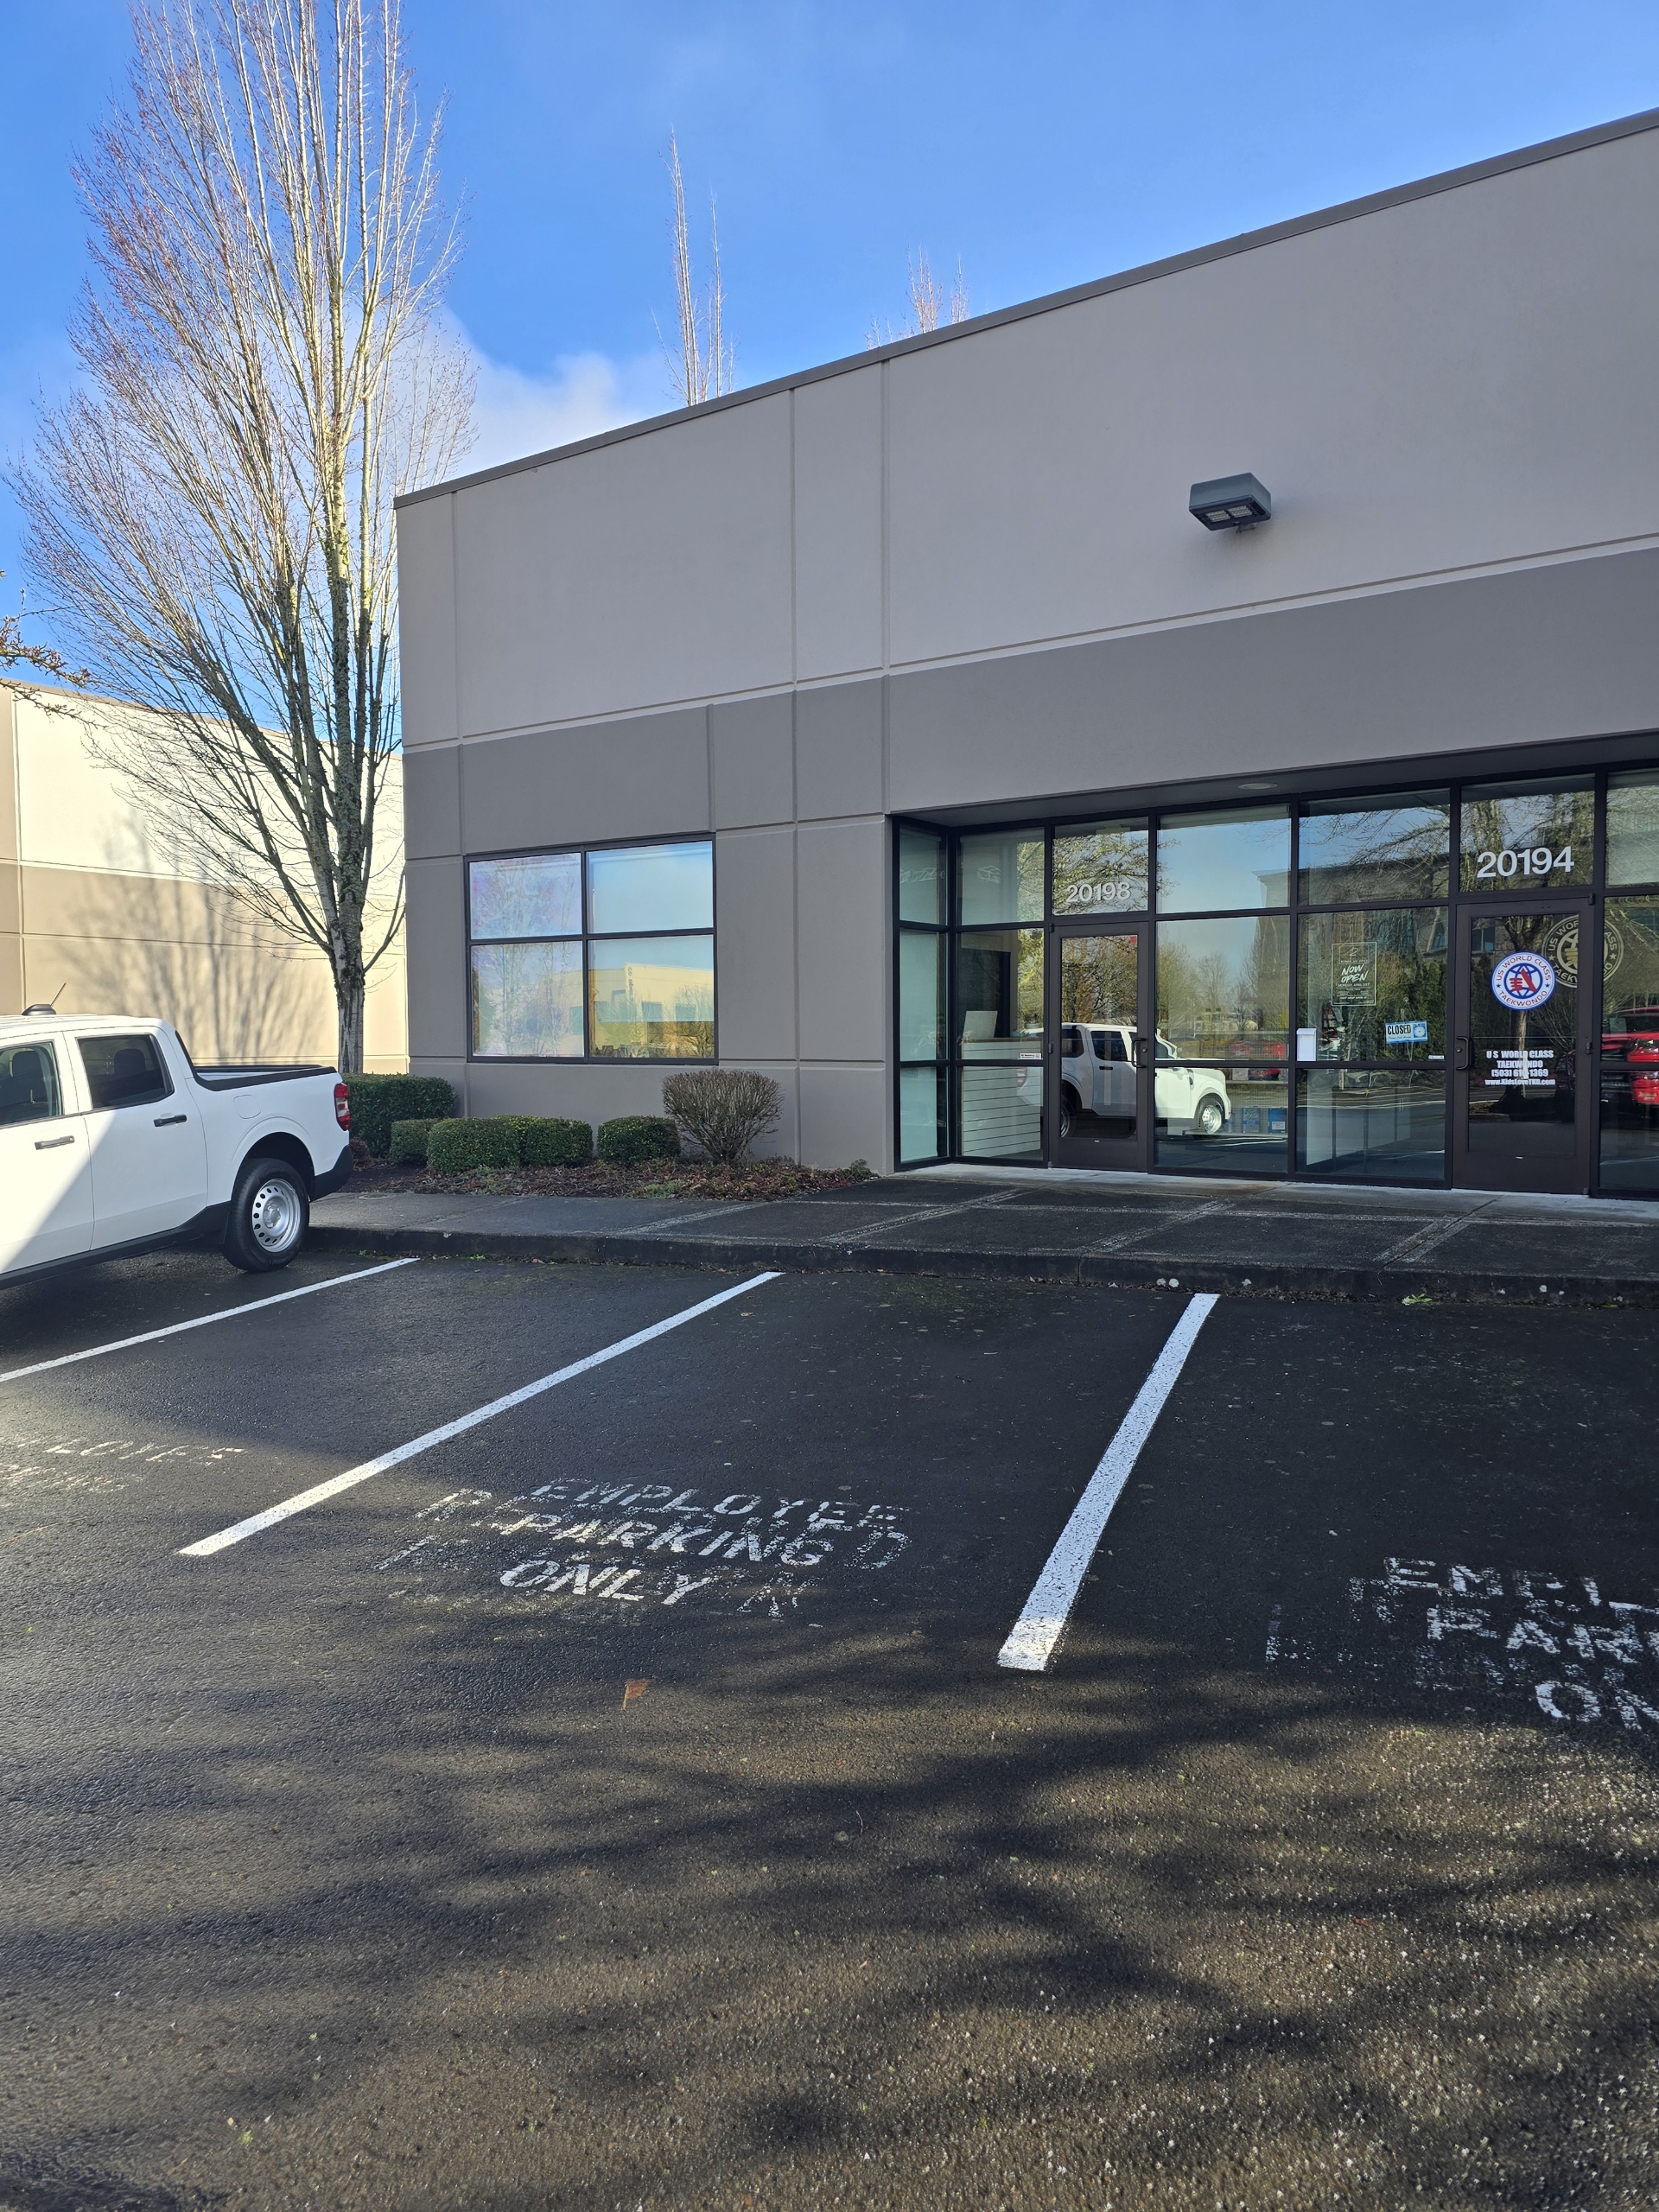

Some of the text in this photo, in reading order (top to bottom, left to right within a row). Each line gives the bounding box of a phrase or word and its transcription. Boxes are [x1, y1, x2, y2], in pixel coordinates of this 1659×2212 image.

[1477, 846, 1574, 878] 20194
[1066, 881, 1131, 902] 20198
[1548, 938, 1559, 951] US
[1341, 963, 1364, 976] NOW
[1341, 969, 1369, 983] OPEN
[1496, 955, 1551, 981] US WORLD CLASS
[1499, 990, 1548, 1007] TAEKWONDO
[1388, 1025, 1411, 1035] CLOSED
[1501, 1050, 1528, 1058] WORLD
[1529, 1050, 1554, 1058] CLASS
[1497, 1060, 1543, 1069] TAEKWONDO
[530, 1478, 909, 1529] EMPLOYEE
[499, 1514, 835, 1567] PARKING
[499, 1560, 719, 1606] ONLY
